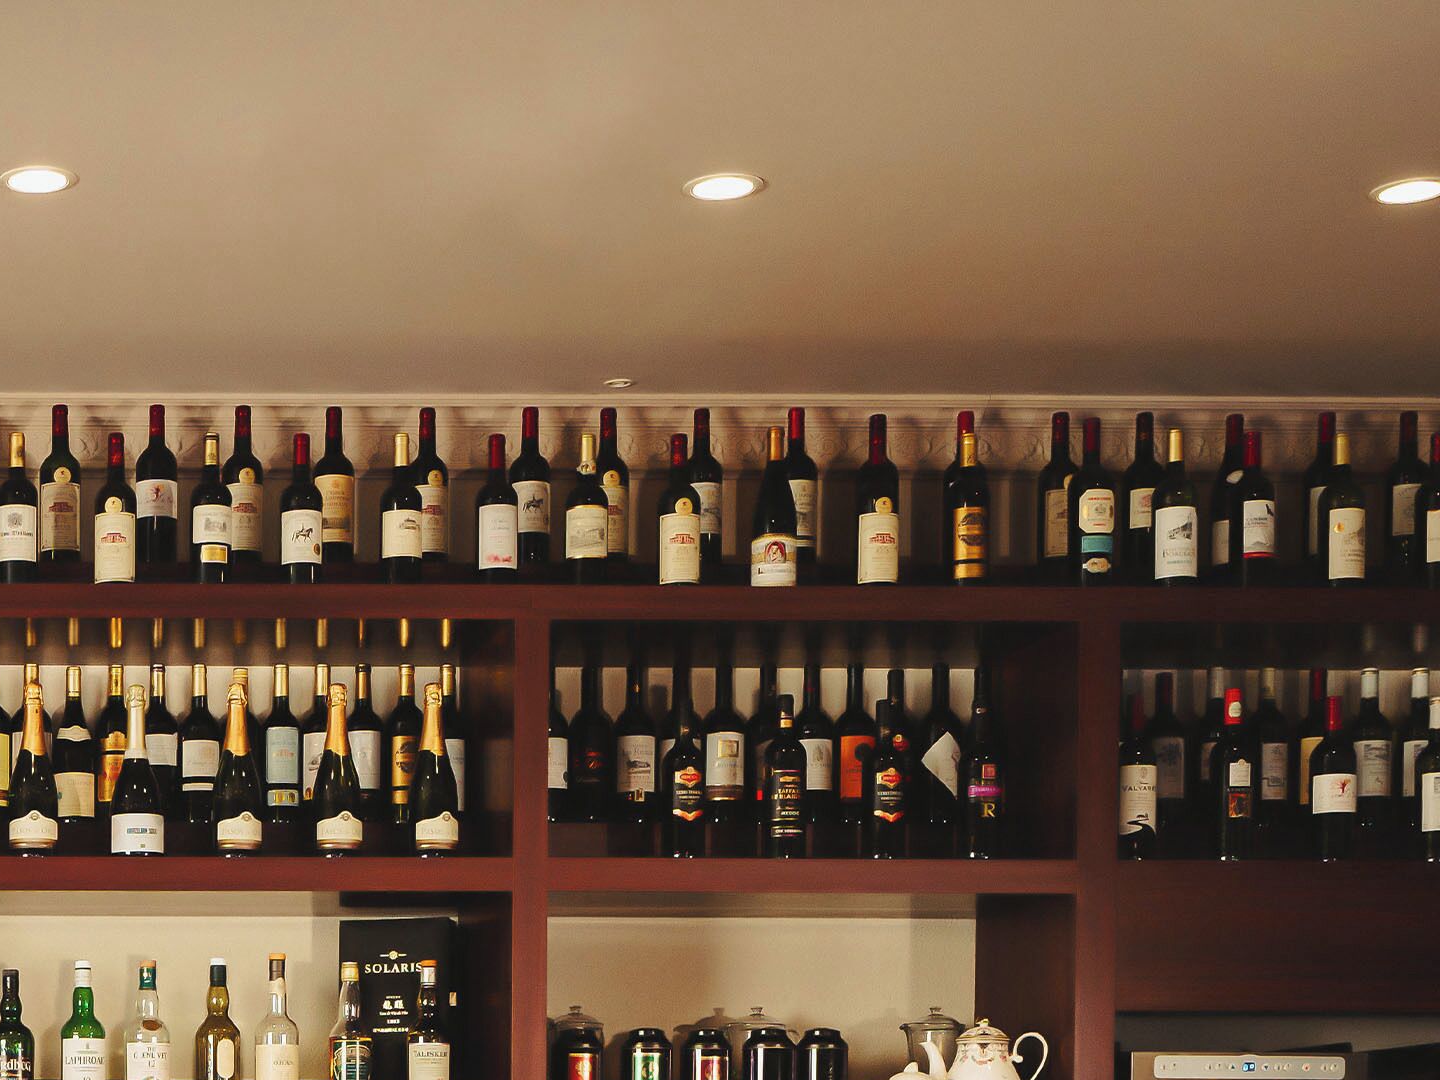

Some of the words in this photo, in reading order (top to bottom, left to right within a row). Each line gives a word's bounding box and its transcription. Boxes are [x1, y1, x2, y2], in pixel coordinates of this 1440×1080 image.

[982, 802, 996, 817] R
[364, 962, 422, 974] SOLARIS
[148, 1060, 157, 1068] 12
